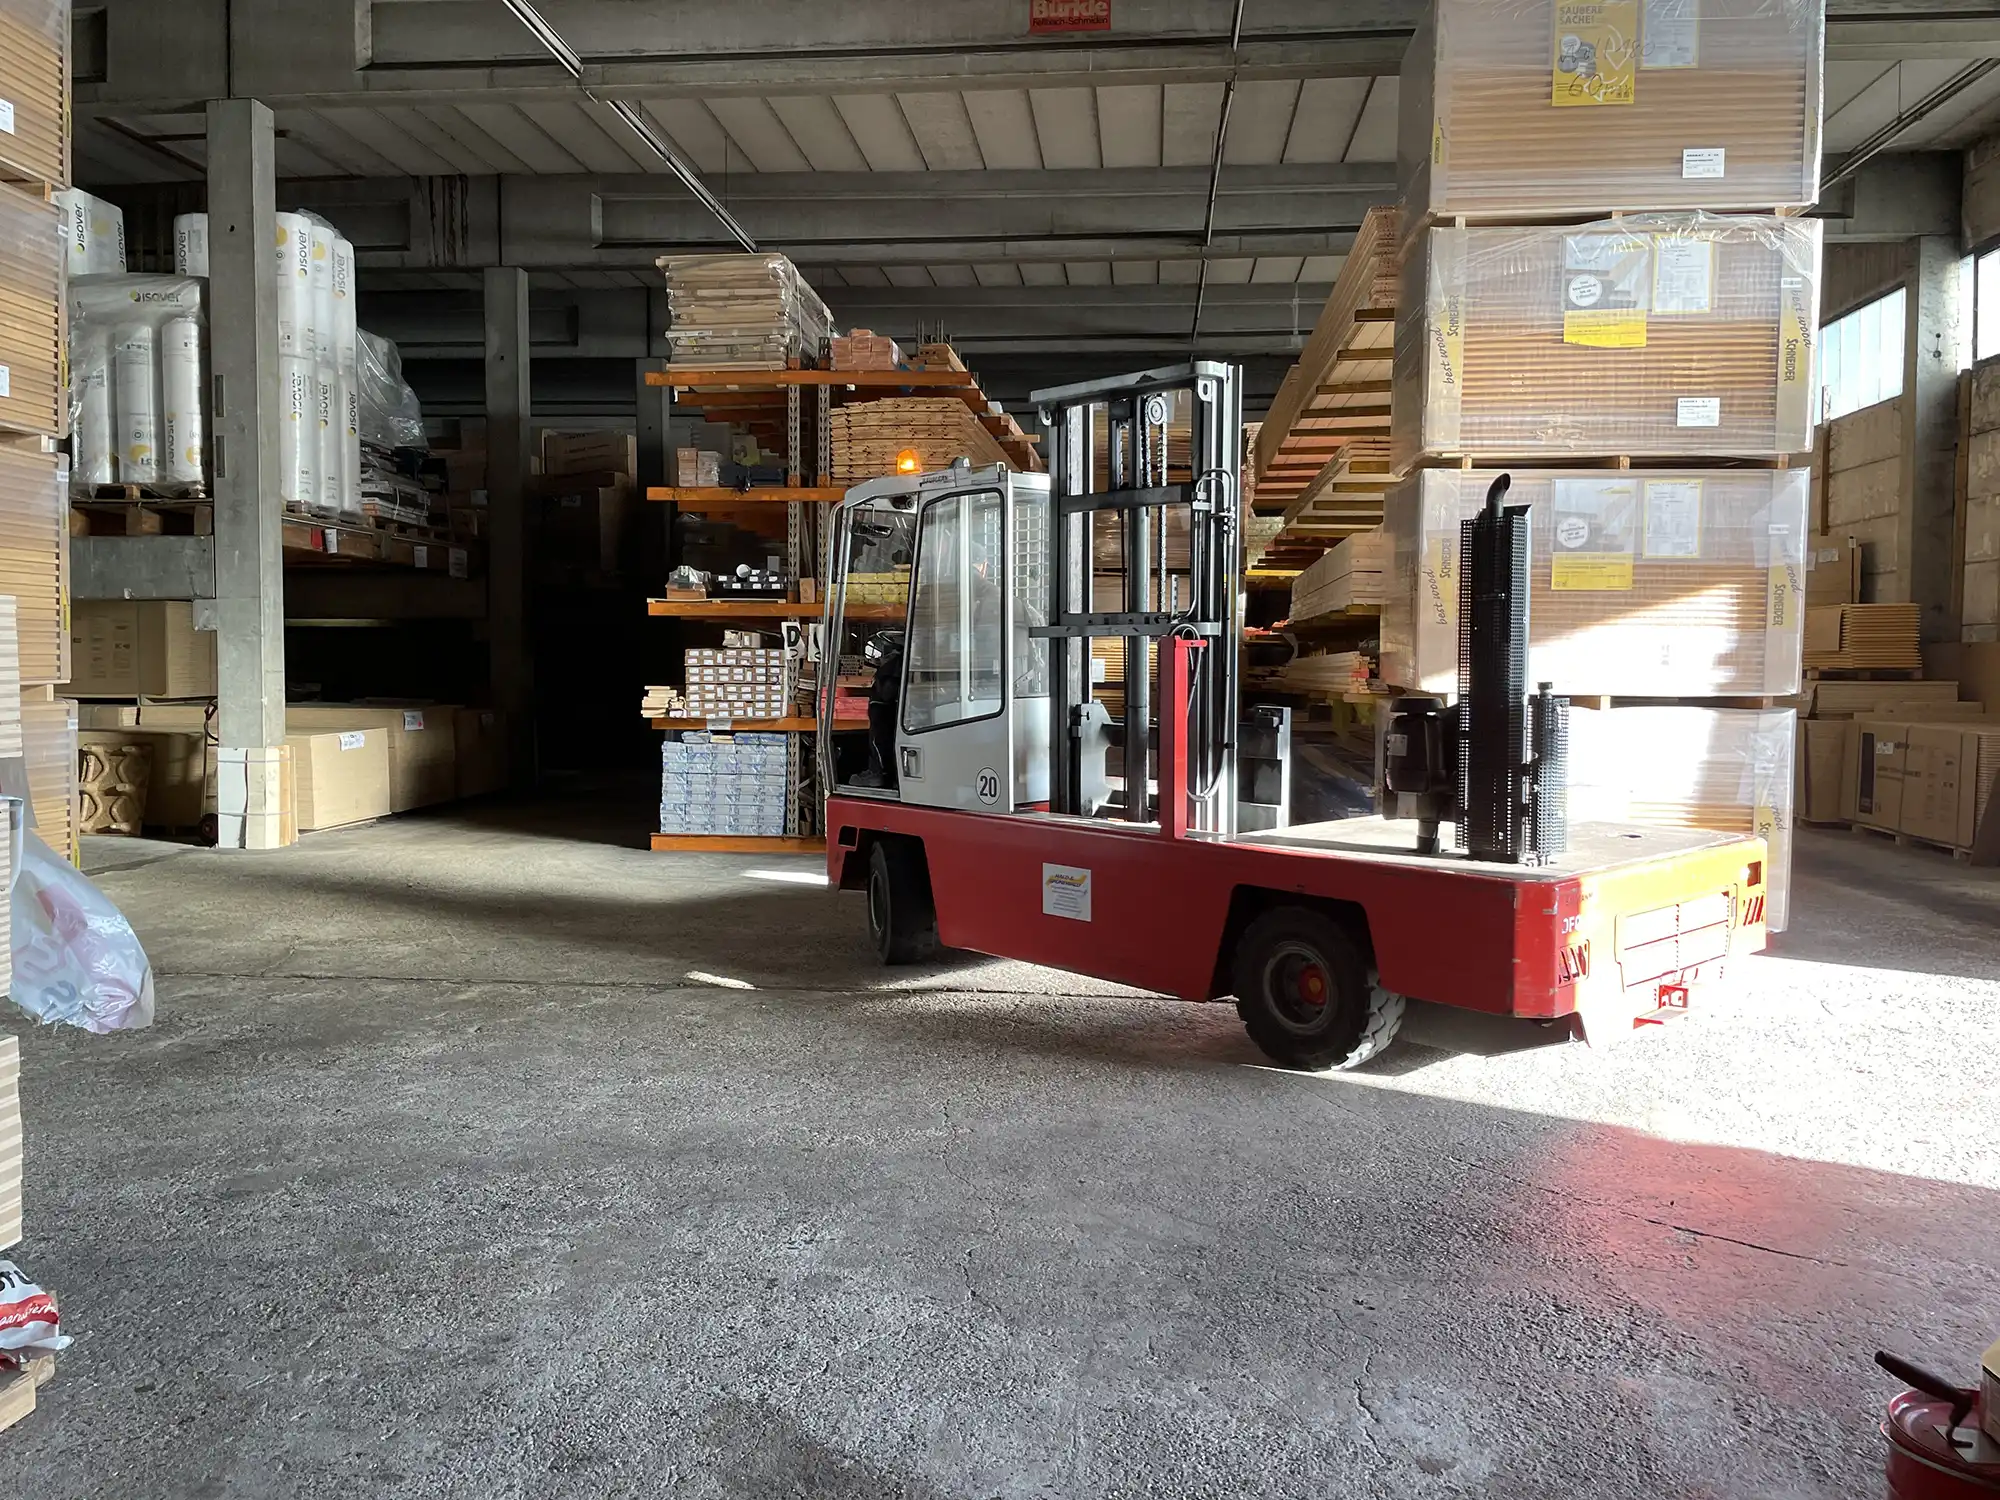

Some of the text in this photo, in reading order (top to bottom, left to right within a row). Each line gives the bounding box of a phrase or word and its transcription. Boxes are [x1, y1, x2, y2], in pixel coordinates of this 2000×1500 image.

[1558, 5, 1604, 16] SAUBERE
[1558, 15, 1596, 26] SACHE!
[74, 202, 85, 246] isover
[115, 219, 125, 261] isover
[178, 230, 187, 268] isover
[298, 228, 308, 268] isover
[336, 252, 345, 289] isover
[141, 290, 182, 305] isover
[1447, 294, 1460, 337] SCHNEIDER
[1428, 327, 1455, 385] best wood
[1784, 338, 1799, 382] SCHNEIDER
[320, 382, 329, 419] isover
[348, 391, 357, 427] isover
[167, 419, 175, 466] isover
[1439, 538, 1453, 579] SCHNEIDER
[1422, 568, 1448, 625] best wood
[1772, 583, 1786, 626] SCHNEIDER
[786, 625, 801, 648] D
[979, 775, 997, 797] 20
